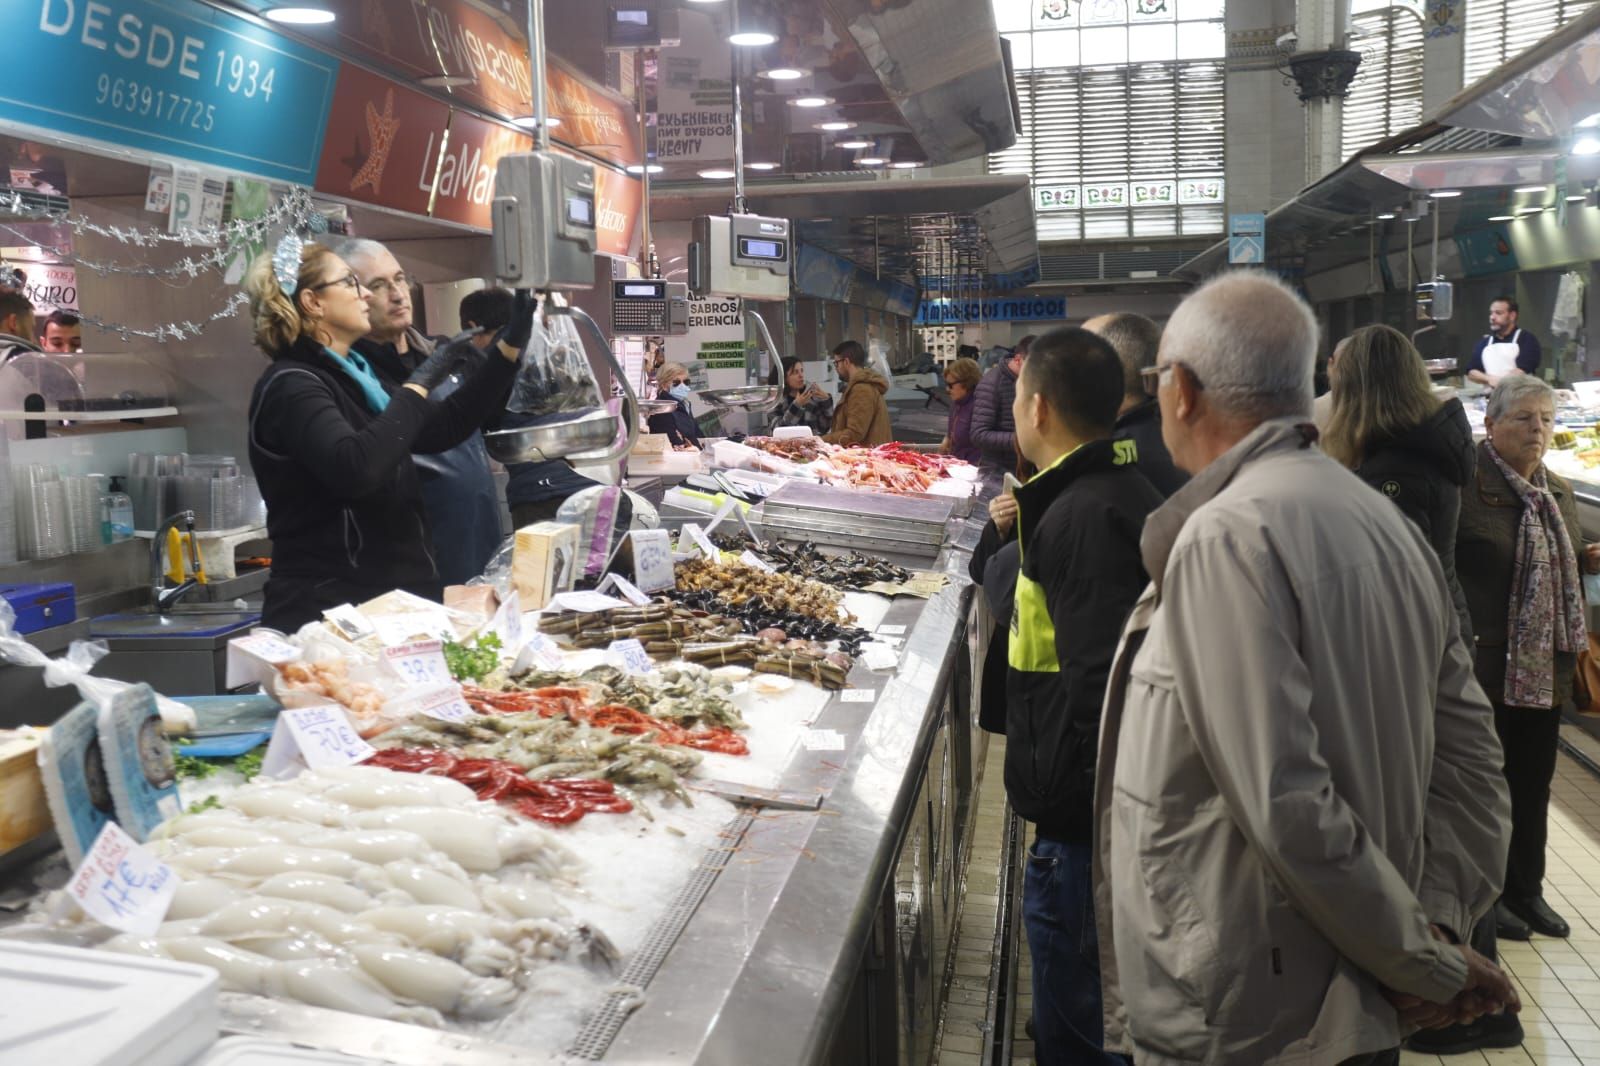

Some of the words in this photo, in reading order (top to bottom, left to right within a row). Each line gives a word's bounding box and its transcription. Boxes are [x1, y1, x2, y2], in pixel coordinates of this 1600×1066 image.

[40, 0, 205, 80] DESDE
[214, 50, 275, 102] 1934
[96, 73, 216, 132] 963917725
[690, 302, 737, 314] SABROS
[1003, 300, 1065, 318] FRESCOS
[689, 315, 742, 327] ERIENCIA
